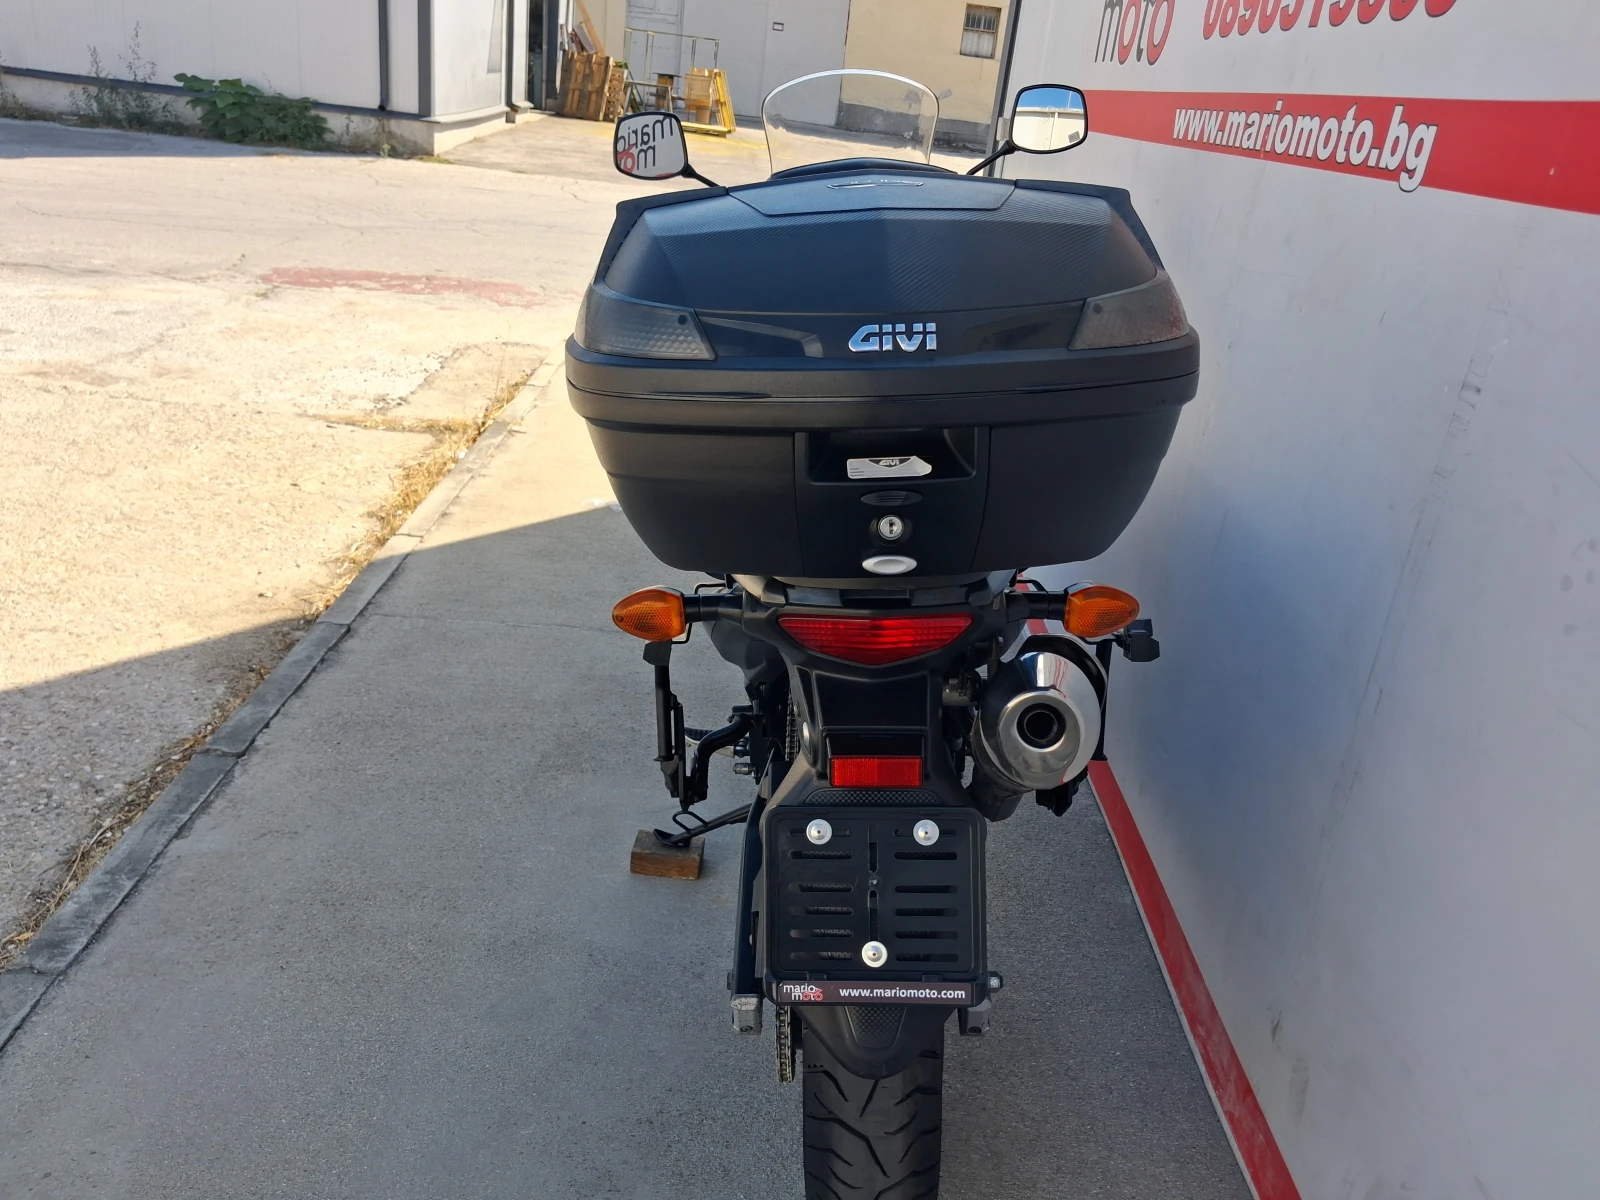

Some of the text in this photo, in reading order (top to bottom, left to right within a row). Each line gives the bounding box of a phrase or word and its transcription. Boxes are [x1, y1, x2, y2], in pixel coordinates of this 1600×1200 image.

[1095, 0, 1175, 66] moto
[1173, 100, 1438, 192] www.mariomoto.bg
[848, 322, 937, 352] GIVI
[783, 983, 816, 993] mario
[791, 991, 823, 1001] moto
[839, 987, 966, 999] www.mariomoto.com
